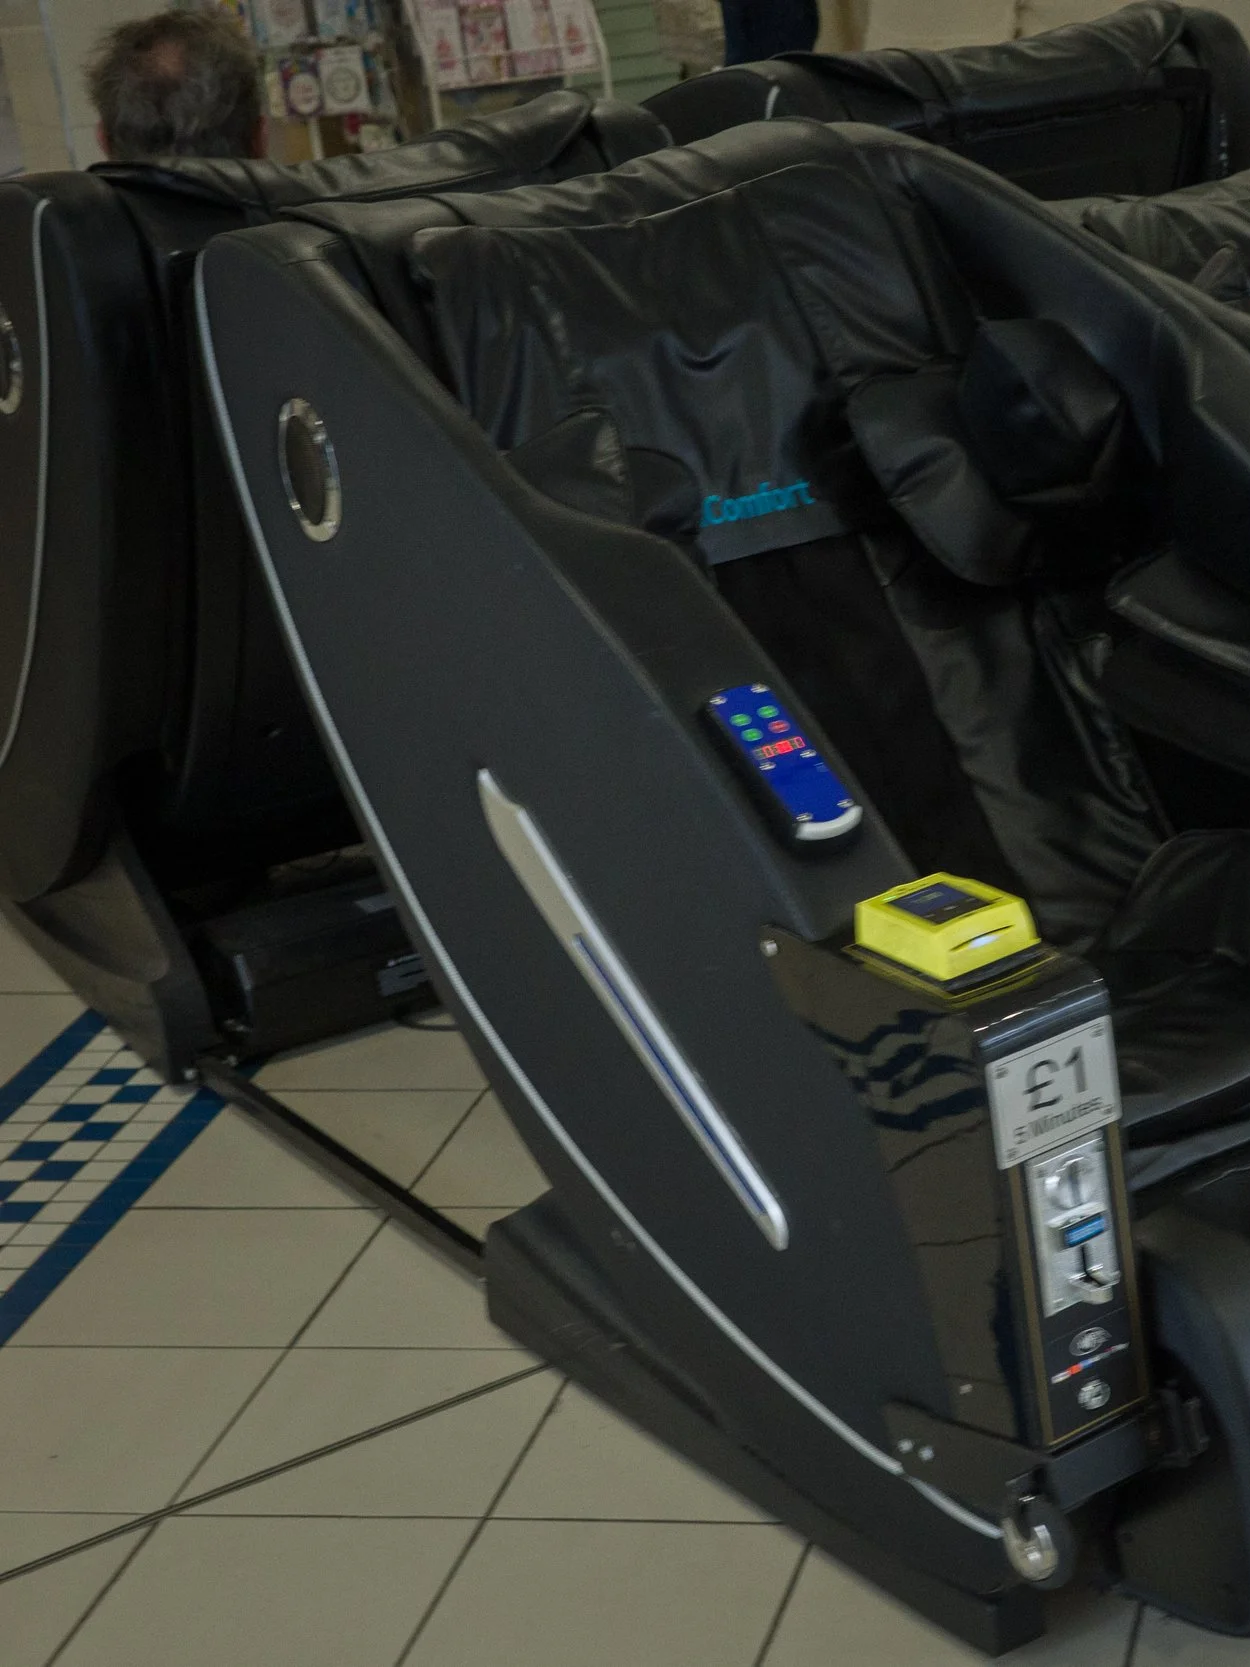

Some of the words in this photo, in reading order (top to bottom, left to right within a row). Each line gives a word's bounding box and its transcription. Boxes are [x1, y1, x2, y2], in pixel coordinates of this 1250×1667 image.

[700, 479, 816, 527] Comfort
[1022, 1045, 1088, 1112] £1
[1013, 1125, 1028, 1145] 5
[1028, 1097, 1103, 1137] Minutes
